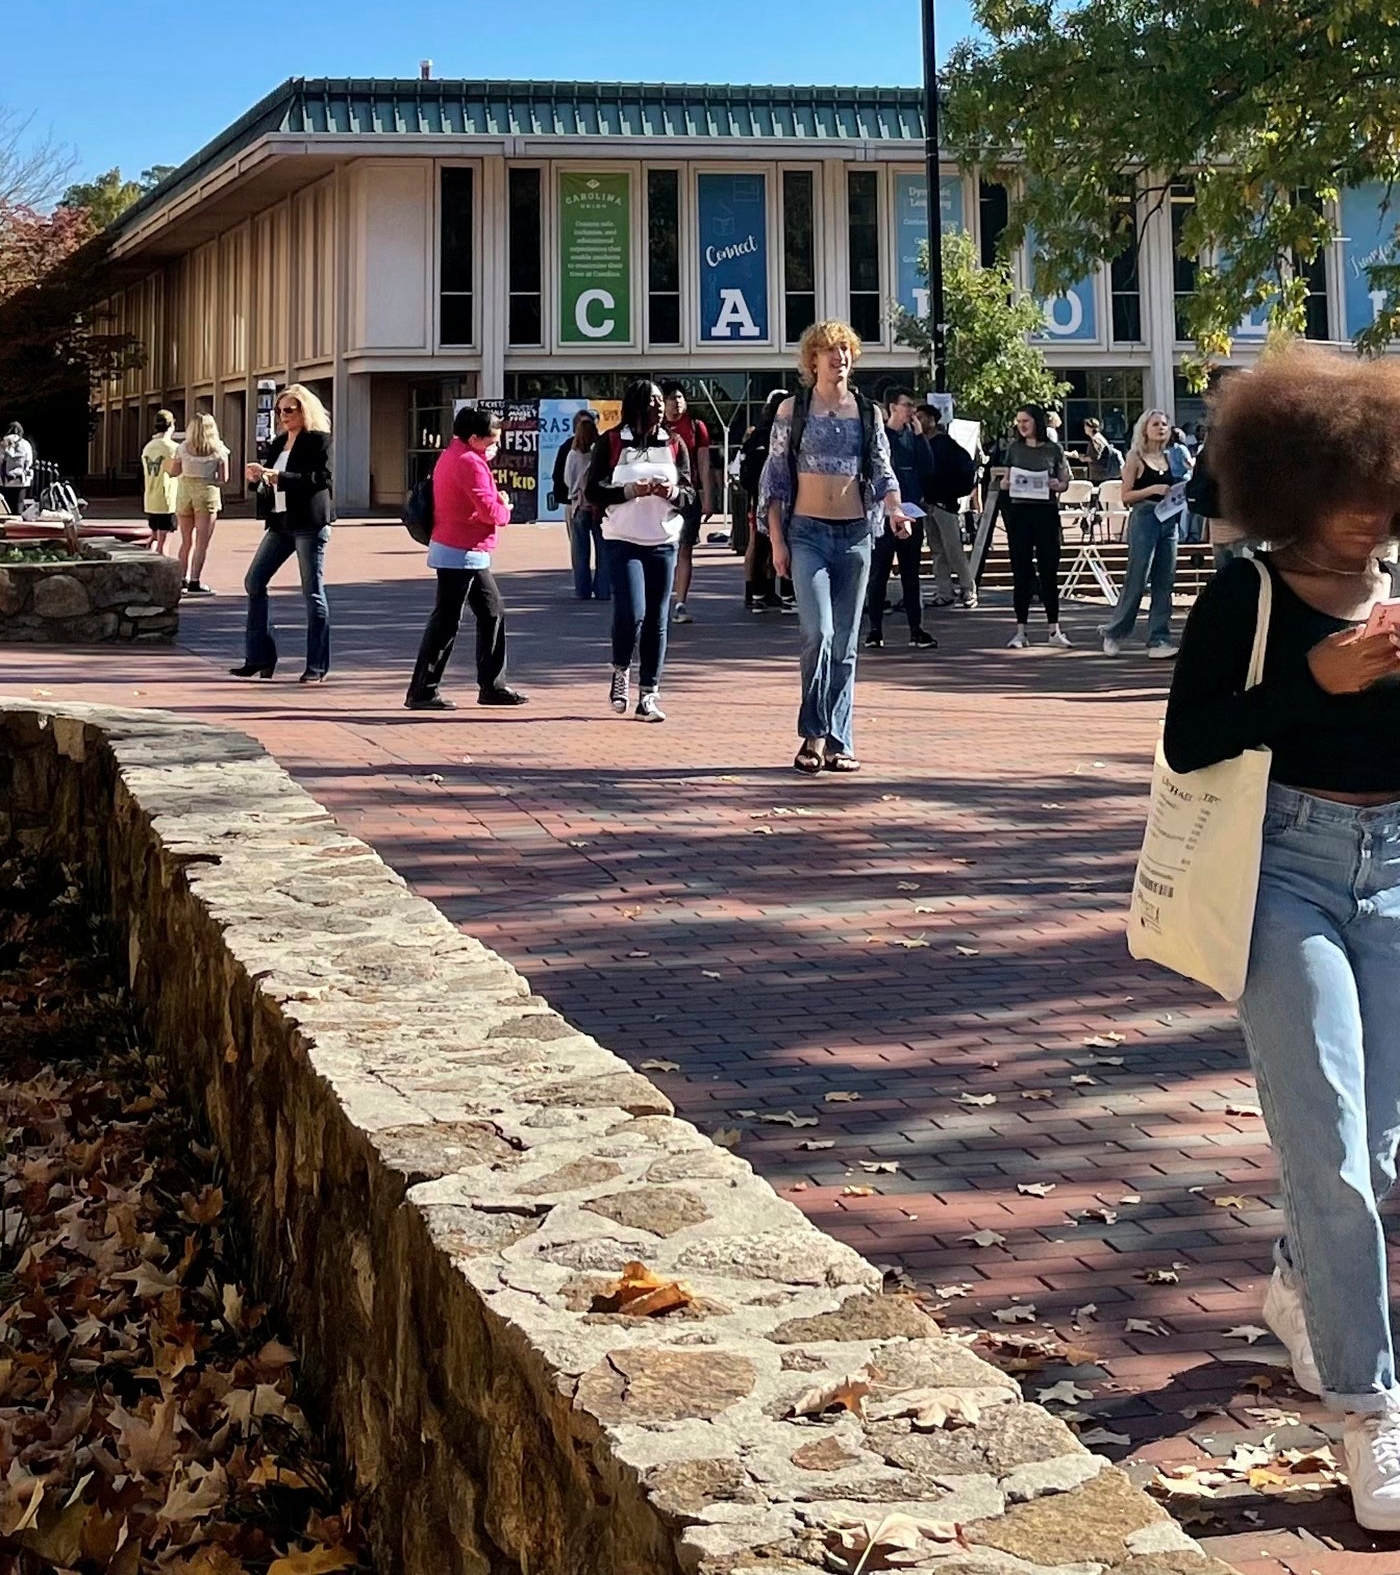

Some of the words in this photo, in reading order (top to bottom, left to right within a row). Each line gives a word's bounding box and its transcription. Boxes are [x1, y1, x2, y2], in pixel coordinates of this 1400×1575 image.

[565, 192, 622, 205] CAROLINA
[908, 186, 951, 197] Dynic
[706, 234, 758, 267] Connect
[575, 289, 615, 337] C
[711, 289, 760, 336] A
[505, 430, 539, 452] FEST
